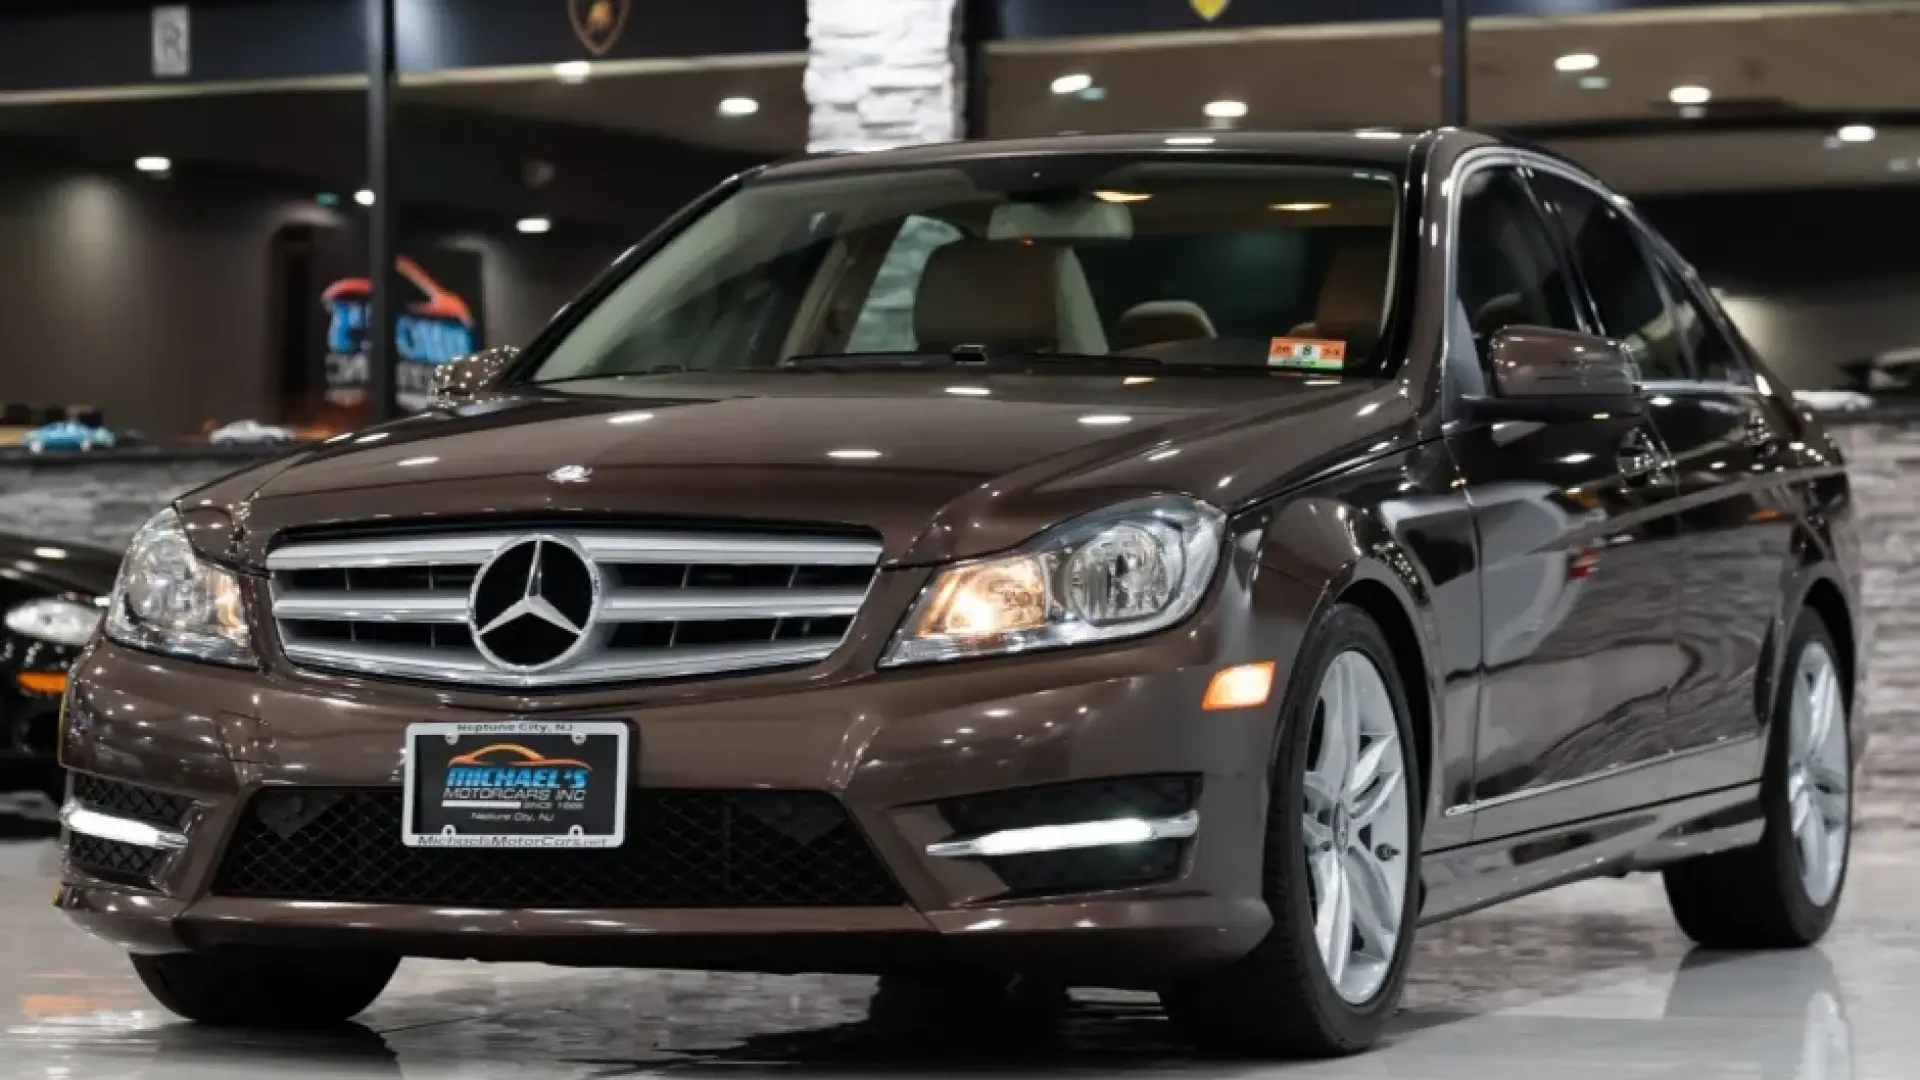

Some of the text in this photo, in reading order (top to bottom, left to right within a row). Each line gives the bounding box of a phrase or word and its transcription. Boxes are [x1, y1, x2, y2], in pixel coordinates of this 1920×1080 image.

[457, 723, 516, 733] Neptune
[555, 723, 573, 732] NJ
[446, 767, 592, 788] MICHAEL'S
[442, 786, 587, 801] MOTORCARS INC
[539, 813, 555, 822] NJ
